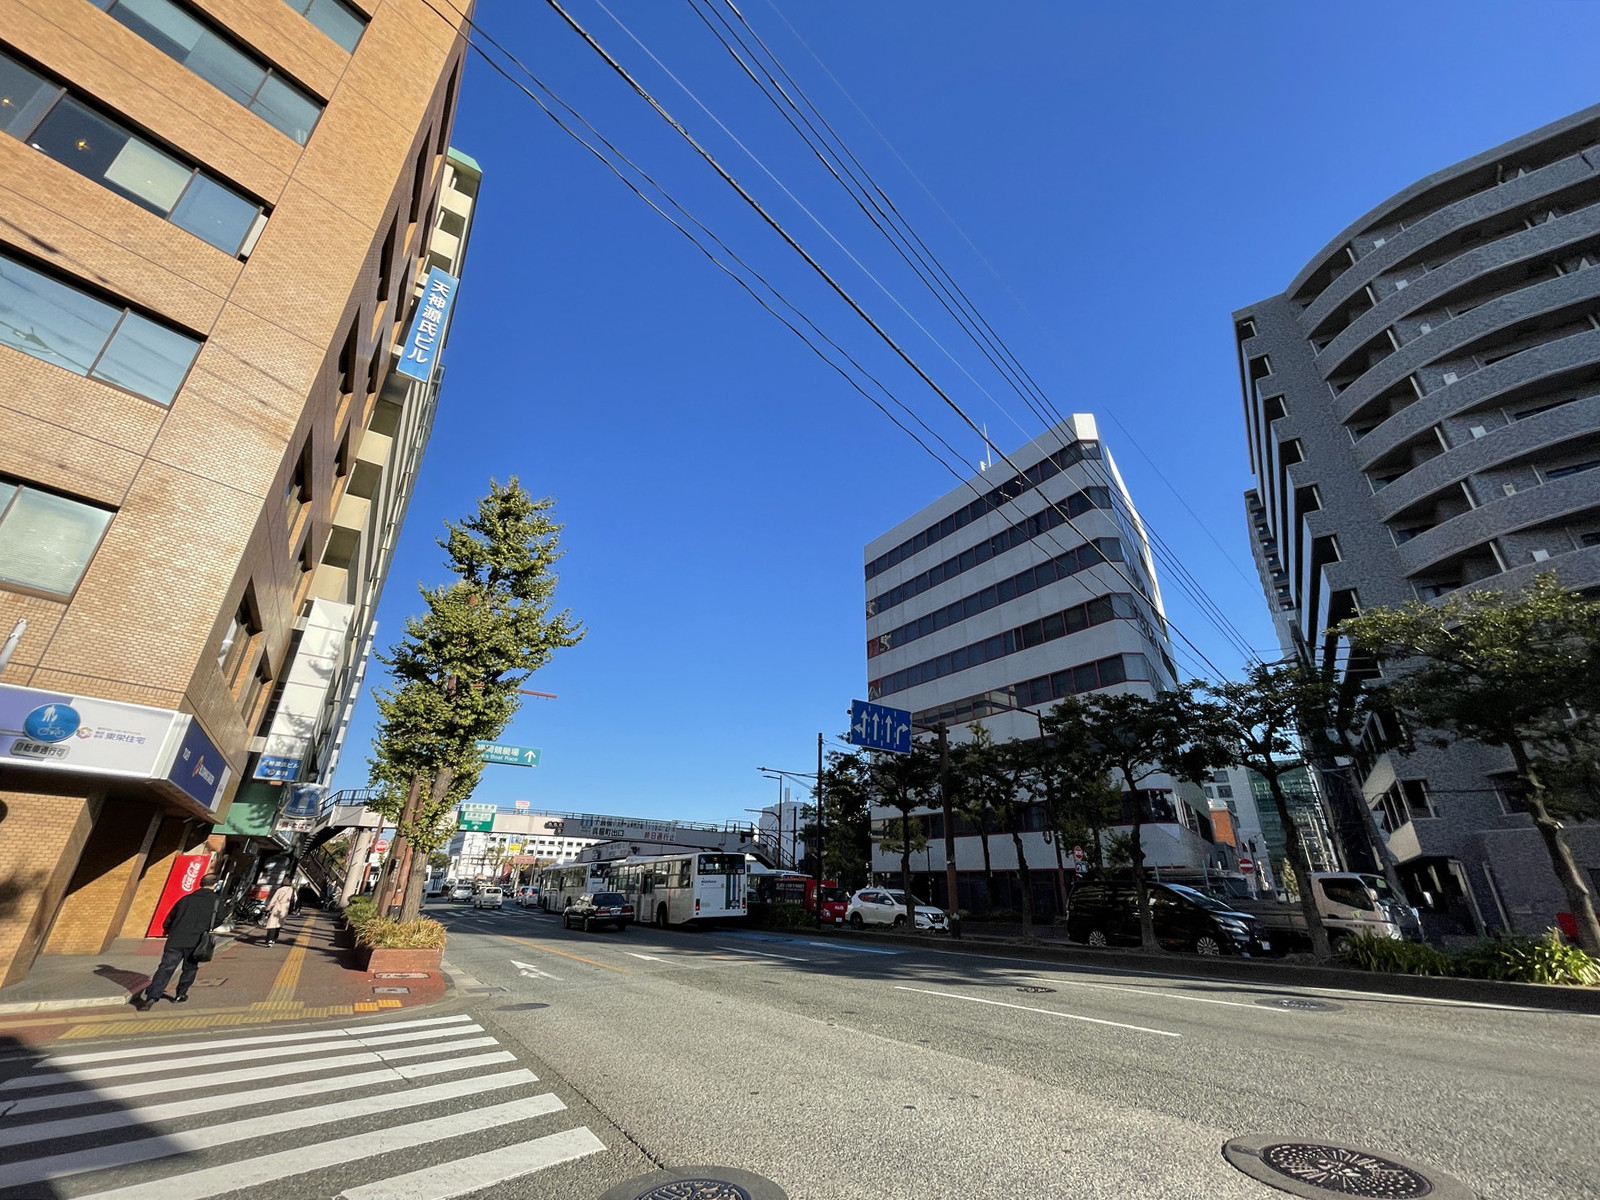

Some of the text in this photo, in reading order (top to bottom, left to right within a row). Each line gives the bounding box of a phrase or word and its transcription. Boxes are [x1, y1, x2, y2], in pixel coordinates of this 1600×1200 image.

[407, 279, 450, 363] 天神源氏ビル
[105, 732, 146, 744] 東栄住宅
[14, 742, 66, 757] 自転車通行可
